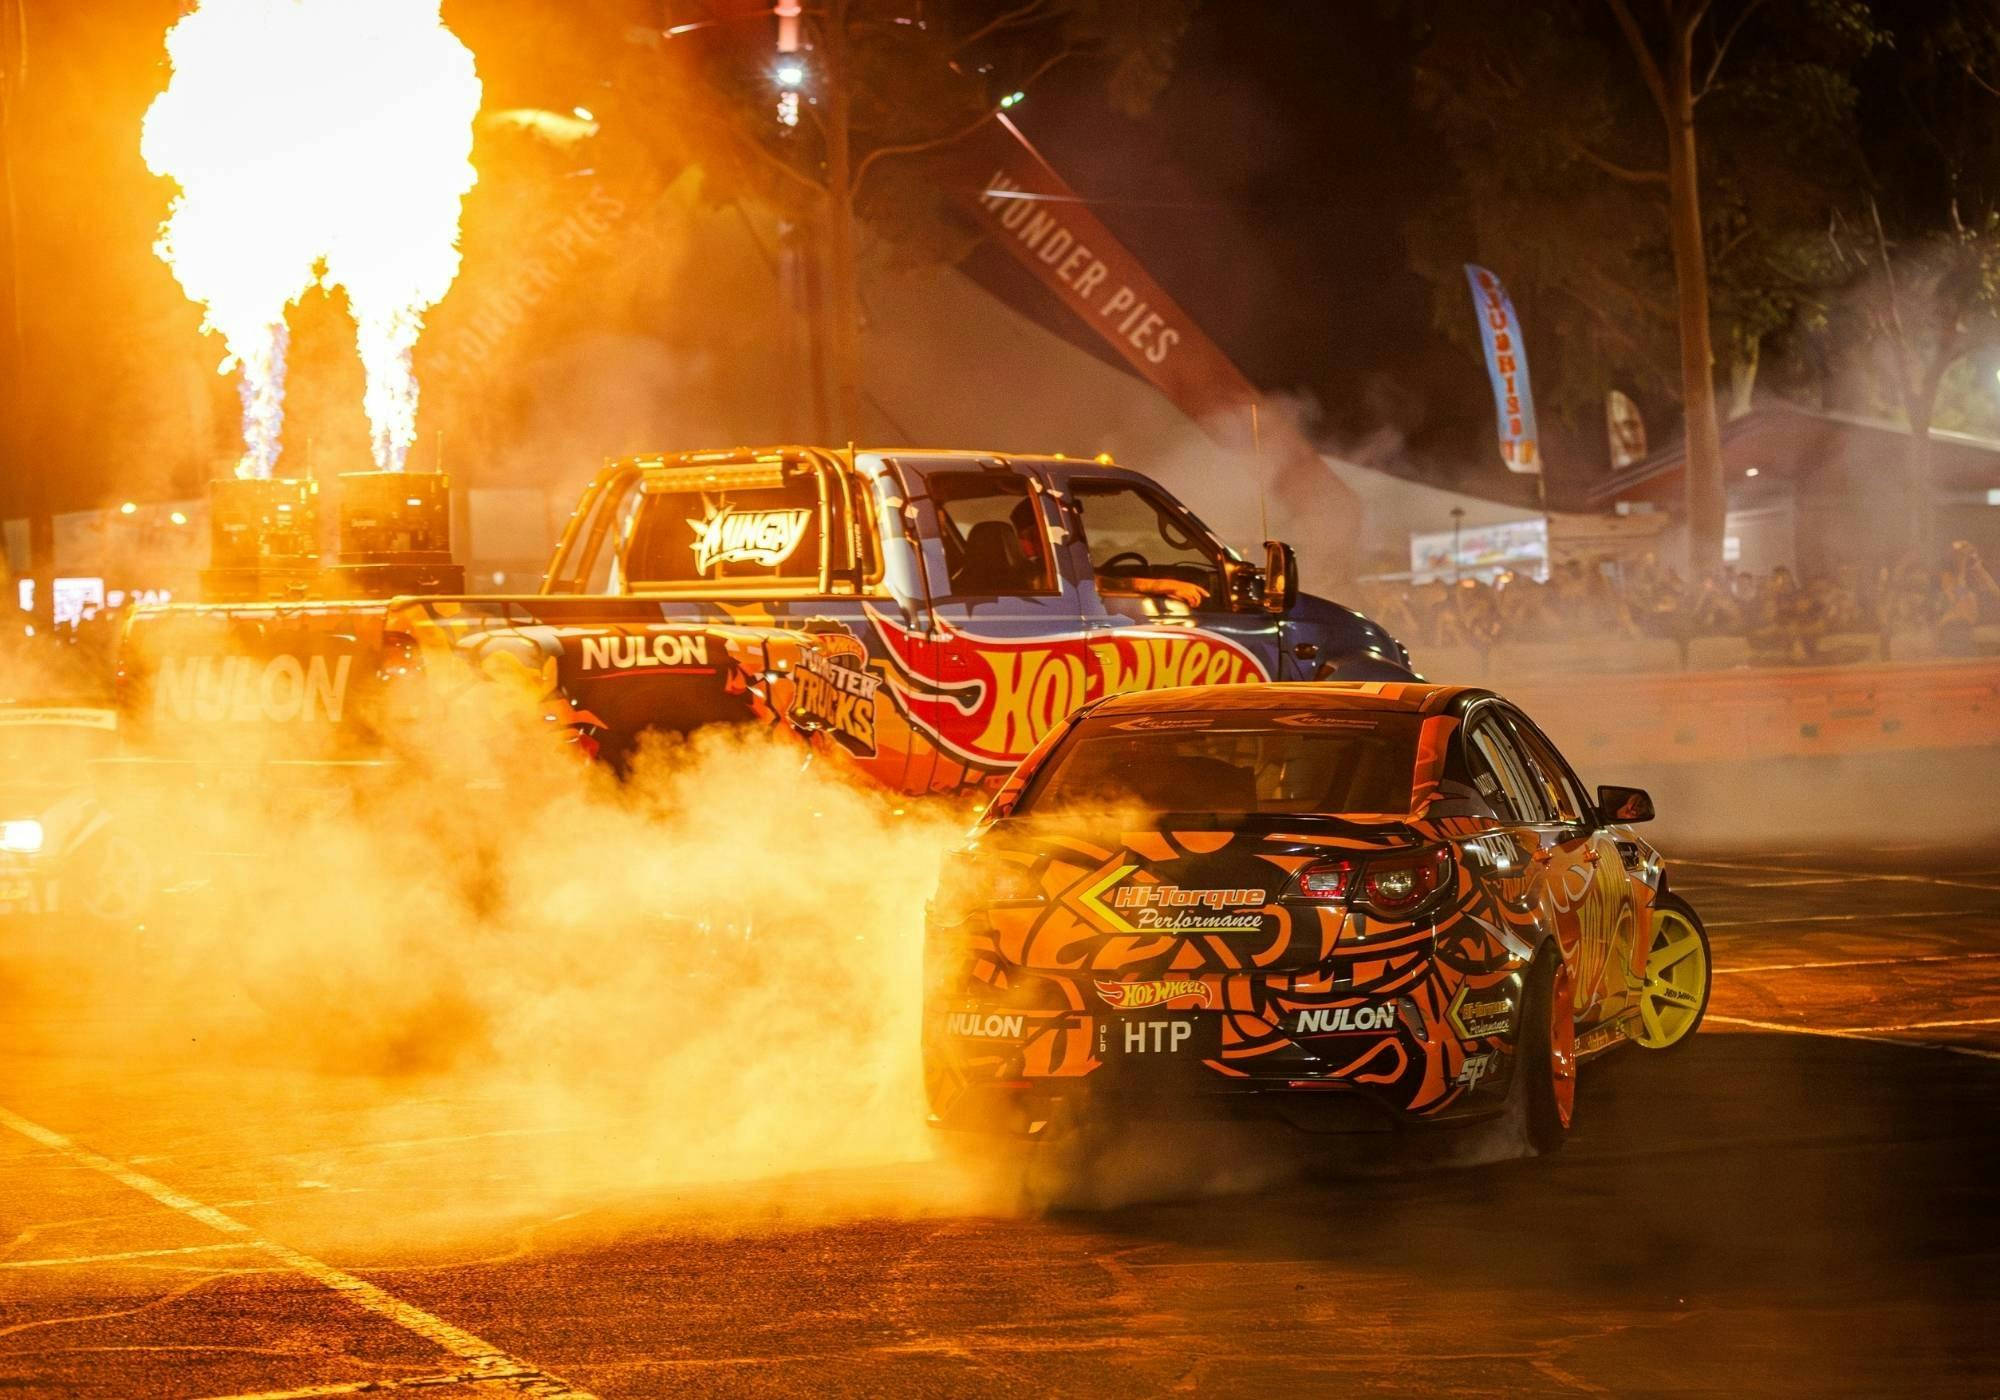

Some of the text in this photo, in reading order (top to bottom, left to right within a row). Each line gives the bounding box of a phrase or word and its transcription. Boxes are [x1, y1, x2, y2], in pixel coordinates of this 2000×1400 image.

[980, 170, 1180, 363] WONDER PIES
[696, 509, 812, 576] MINGAY
[581, 635, 708, 670] NULON
[153, 654, 352, 722] NULON
[795, 665, 875, 751] TRUCKS
[1114, 885, 1266, 911] Hi-Torque
[1138, 908, 1264, 934] Performance
[947, 1012, 1024, 1038] NULON
[1296, 1006, 1395, 1032] NULON
[1124, 1020, 1192, 1054] HTP
